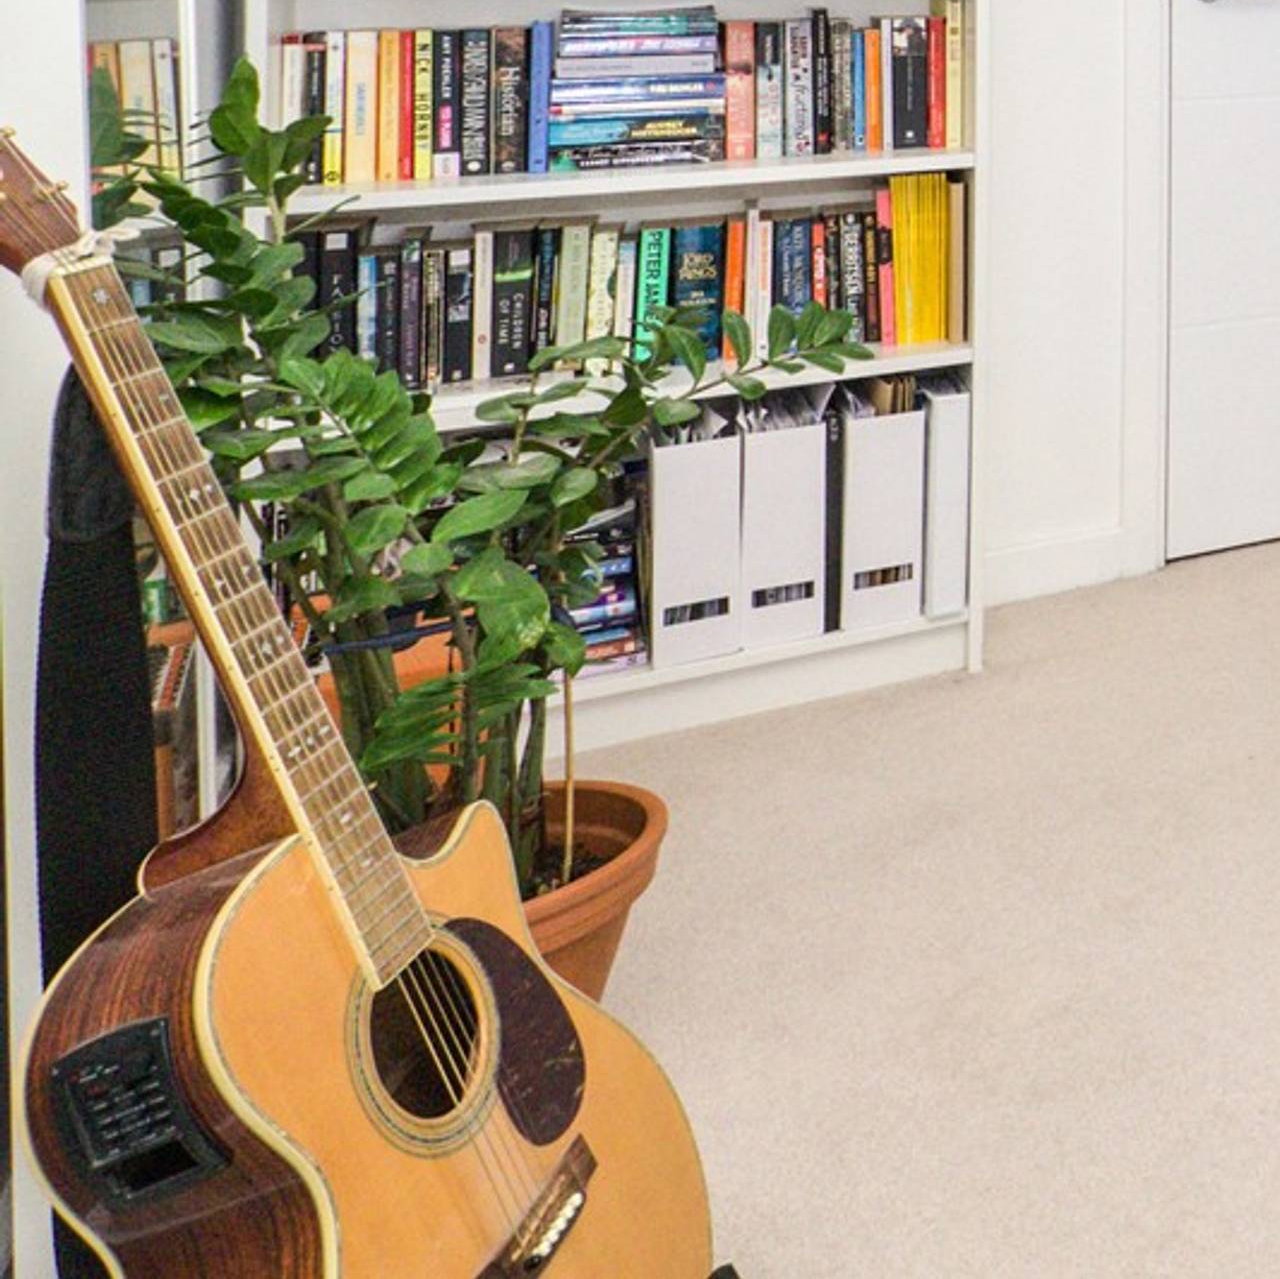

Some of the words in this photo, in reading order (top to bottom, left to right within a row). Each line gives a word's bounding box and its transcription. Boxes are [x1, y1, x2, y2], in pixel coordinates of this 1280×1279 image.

[417, 42, 430, 74] NICK
[441, 34, 452, 54] AMY
[441, 57, 452, 98] POEHLER
[415, 92, 431, 151] HORNBY
[499, 66, 523, 137] Historian
[646, 230, 664, 280] PETER
[499, 298, 510, 314] OF
[512, 292, 525, 350] CHILDREN
[498, 318, 510, 346] TIME
